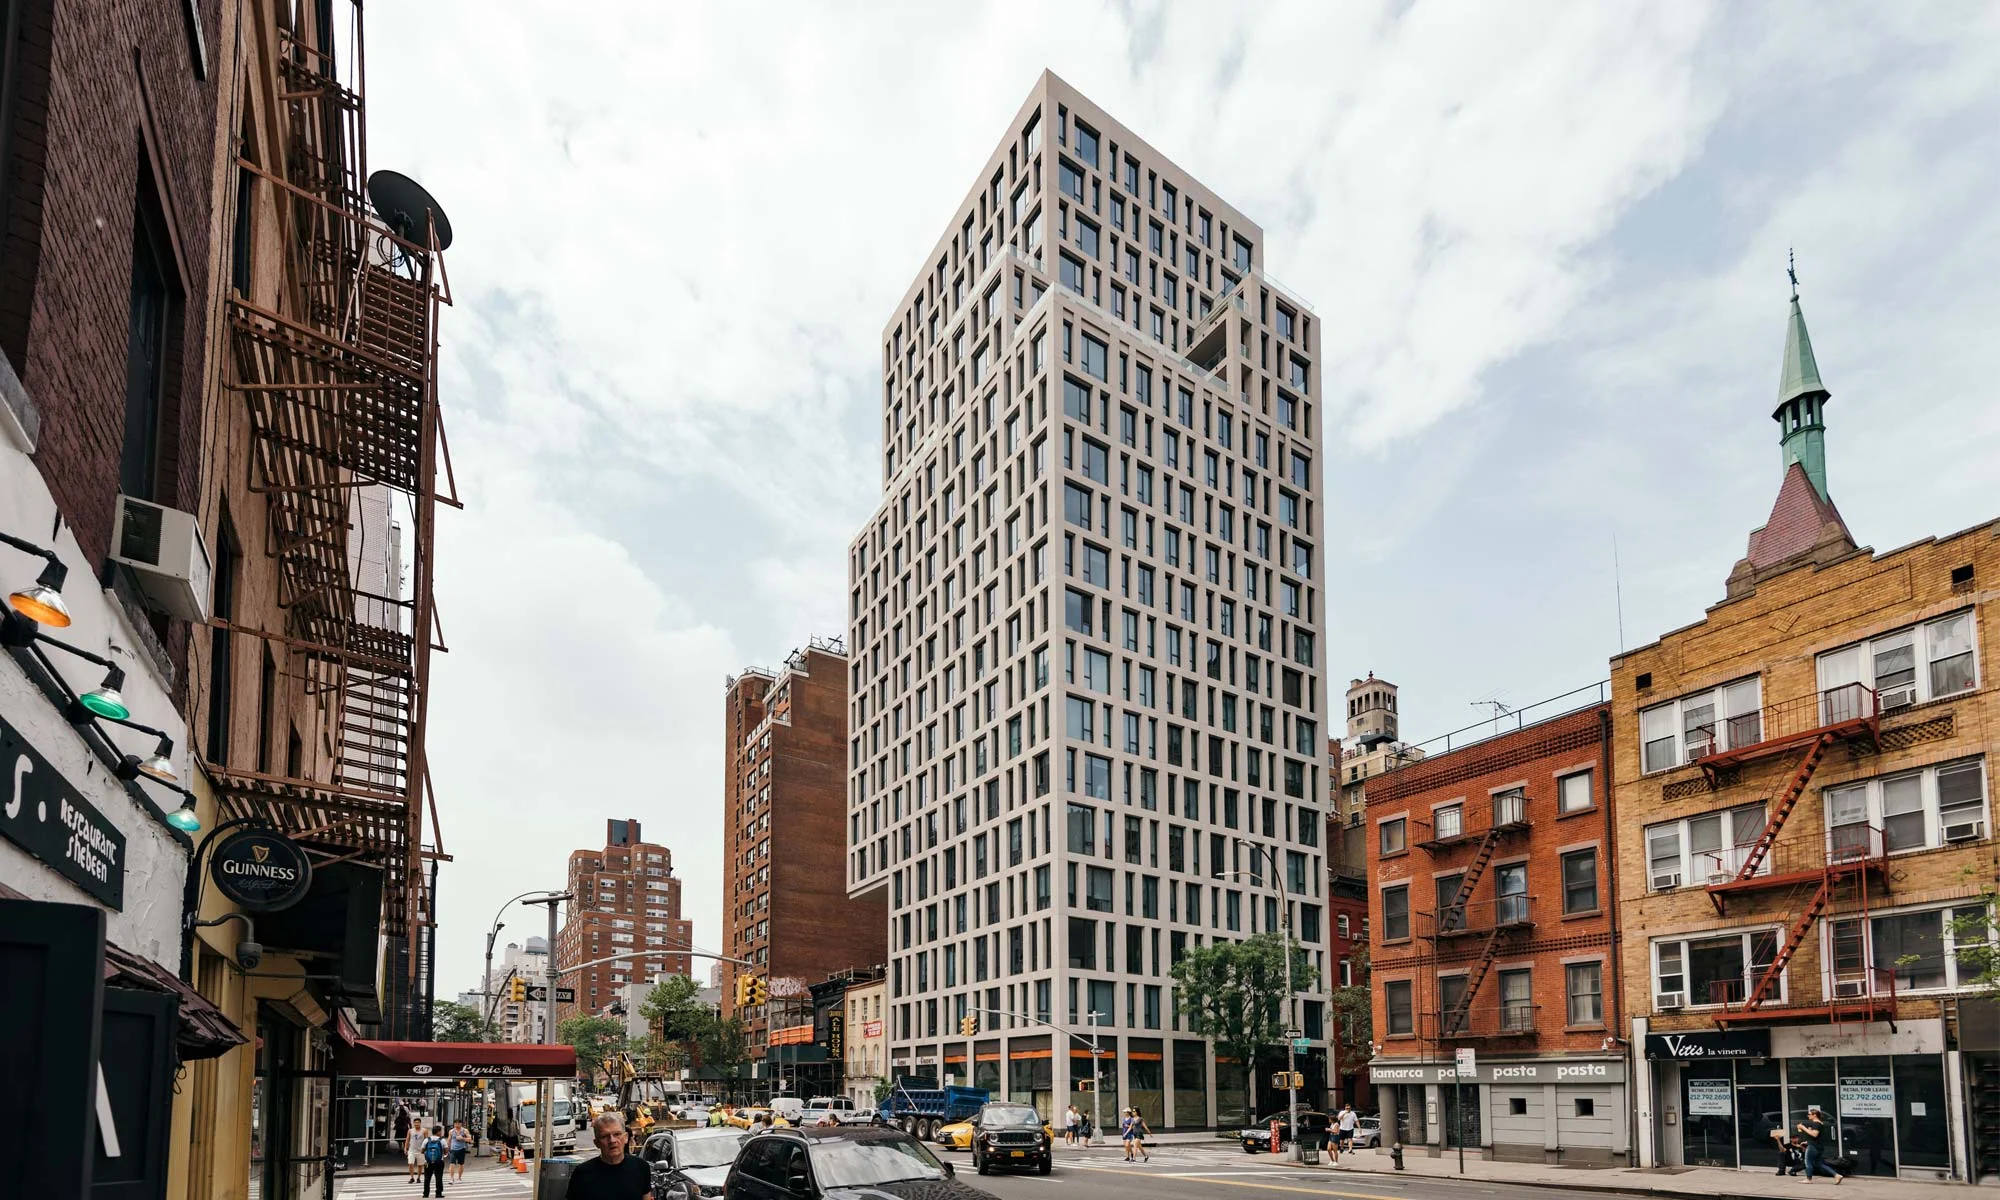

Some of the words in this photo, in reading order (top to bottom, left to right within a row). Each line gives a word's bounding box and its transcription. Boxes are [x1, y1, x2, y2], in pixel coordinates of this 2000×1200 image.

[223, 859, 296, 880] GUINNESS
[1661, 1035, 1704, 1056] Vitis
[1707, 1048, 1716, 1056] la
[1717, 1048, 1747, 1056] vineria
[415, 1065, 430, 1073] 24/7
[459, 1064, 502, 1076] Lyric
[502, 1065, 522, 1075] Diner
[1372, 1067, 1424, 1078] lamarca
[1493, 1065, 1537, 1080] pasta
[1557, 1063, 1606, 1079] pasta
